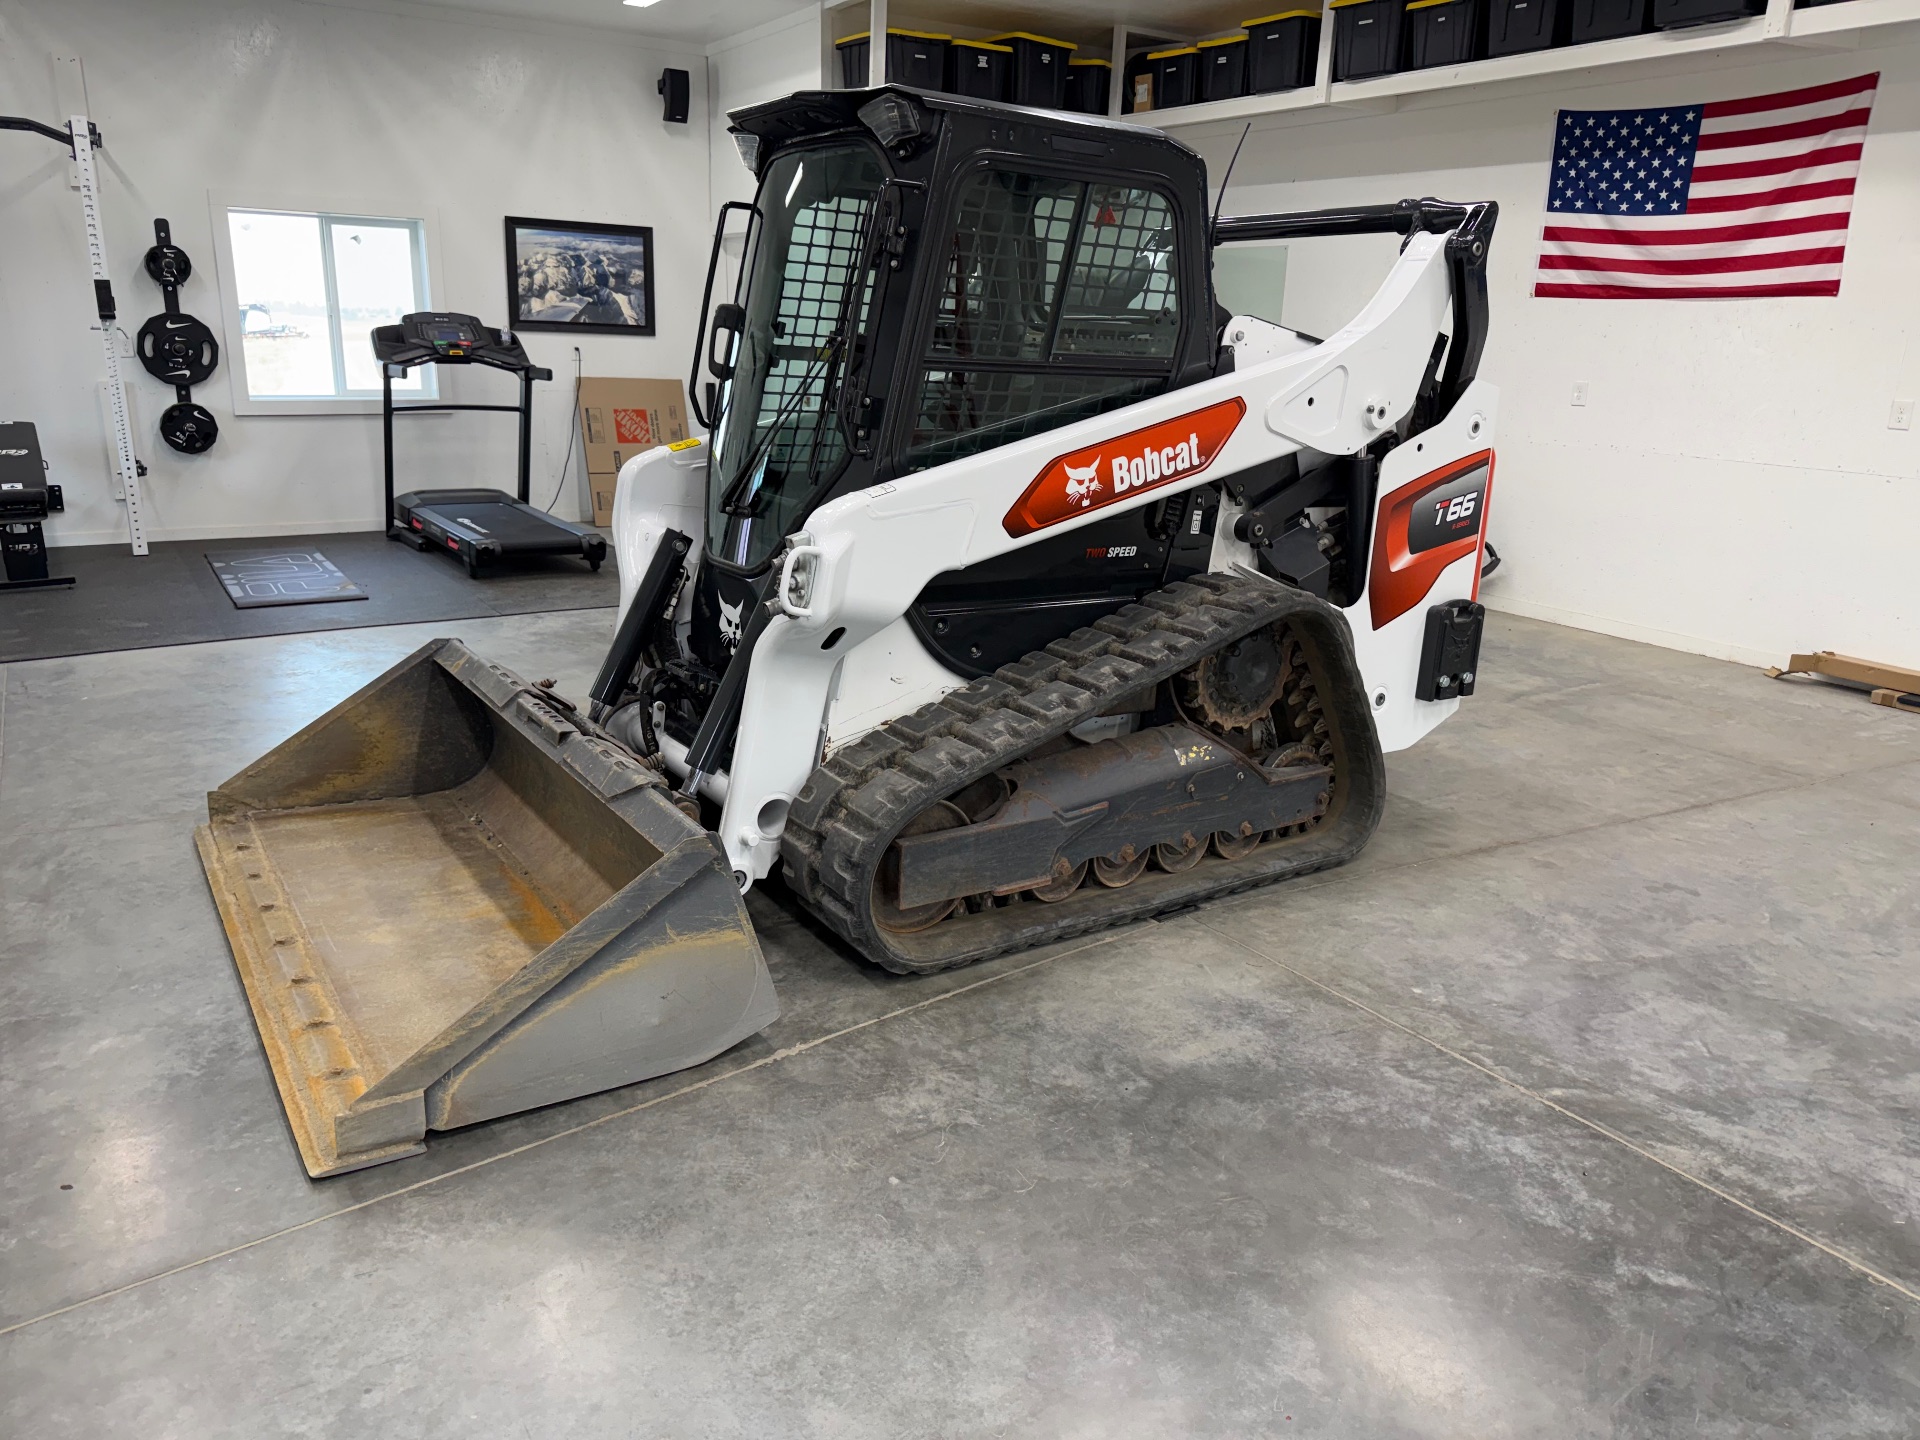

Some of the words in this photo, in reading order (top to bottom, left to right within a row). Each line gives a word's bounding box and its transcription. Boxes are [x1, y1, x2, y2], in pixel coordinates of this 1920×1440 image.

[613, 408, 651, 444] HOME
[626, 409, 649, 431] DEPOT
[1111, 432, 1200, 494] Bobcat
[1435, 491, 1478, 526] T66
[1085, 547, 1107, 558] TWO
[1107, 546, 1137, 558] SPEED
